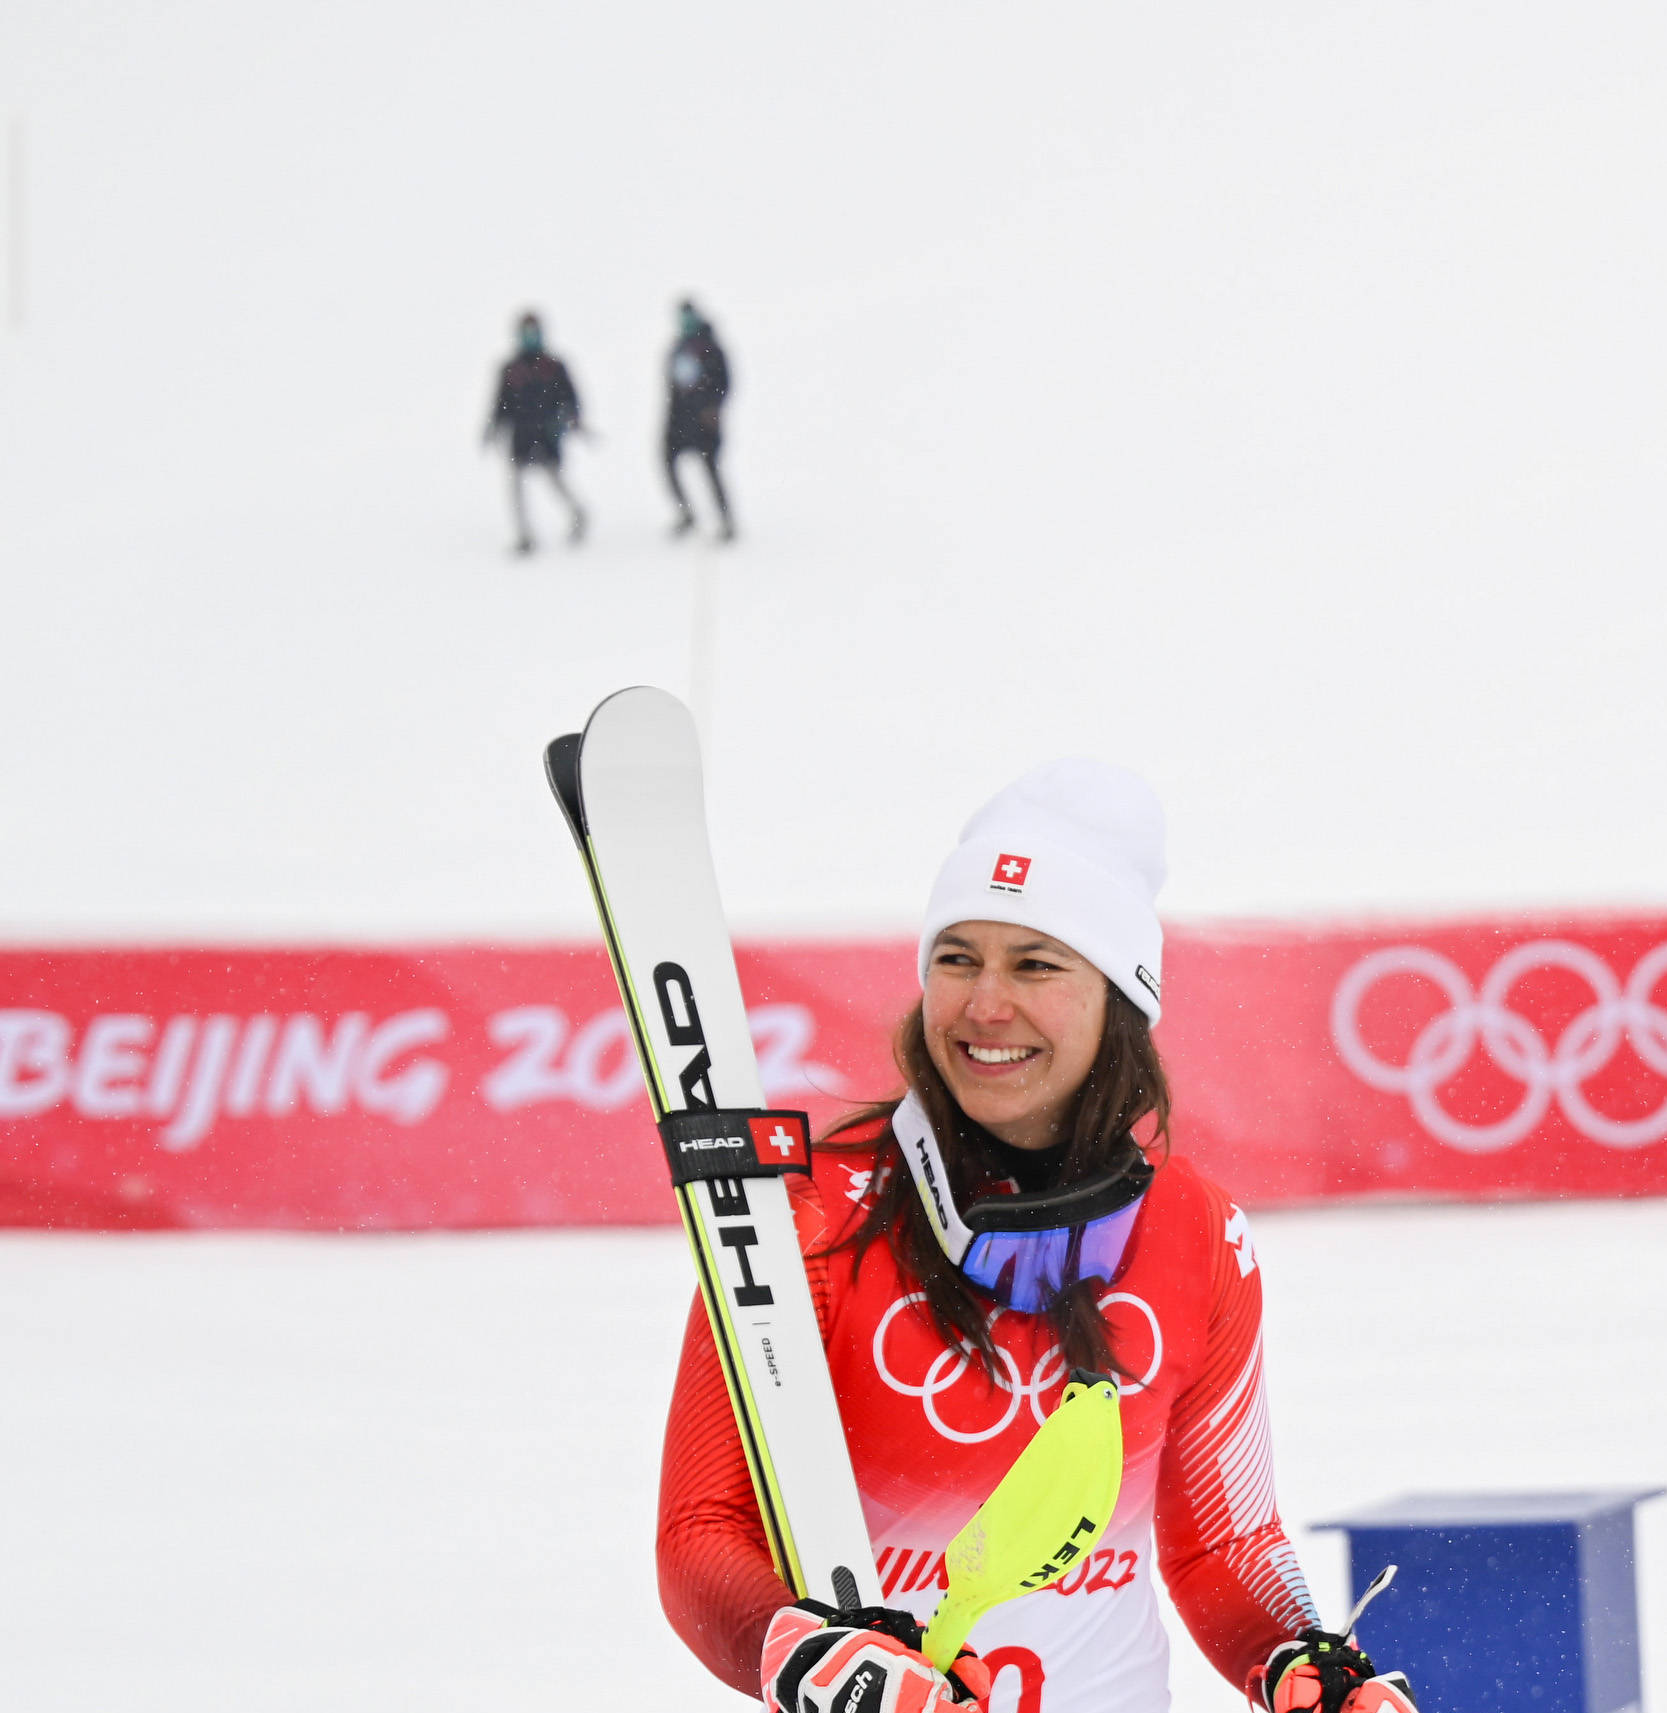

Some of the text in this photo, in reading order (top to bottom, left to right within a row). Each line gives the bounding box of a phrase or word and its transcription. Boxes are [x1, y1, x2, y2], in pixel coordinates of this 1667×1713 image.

[0, 1002, 850, 1152] BEIJING 202
[679, 1137, 745, 1153] HEAD
[916, 1137, 949, 1231] HEAD
[1019, 1516, 1097, 1588] LEKI
